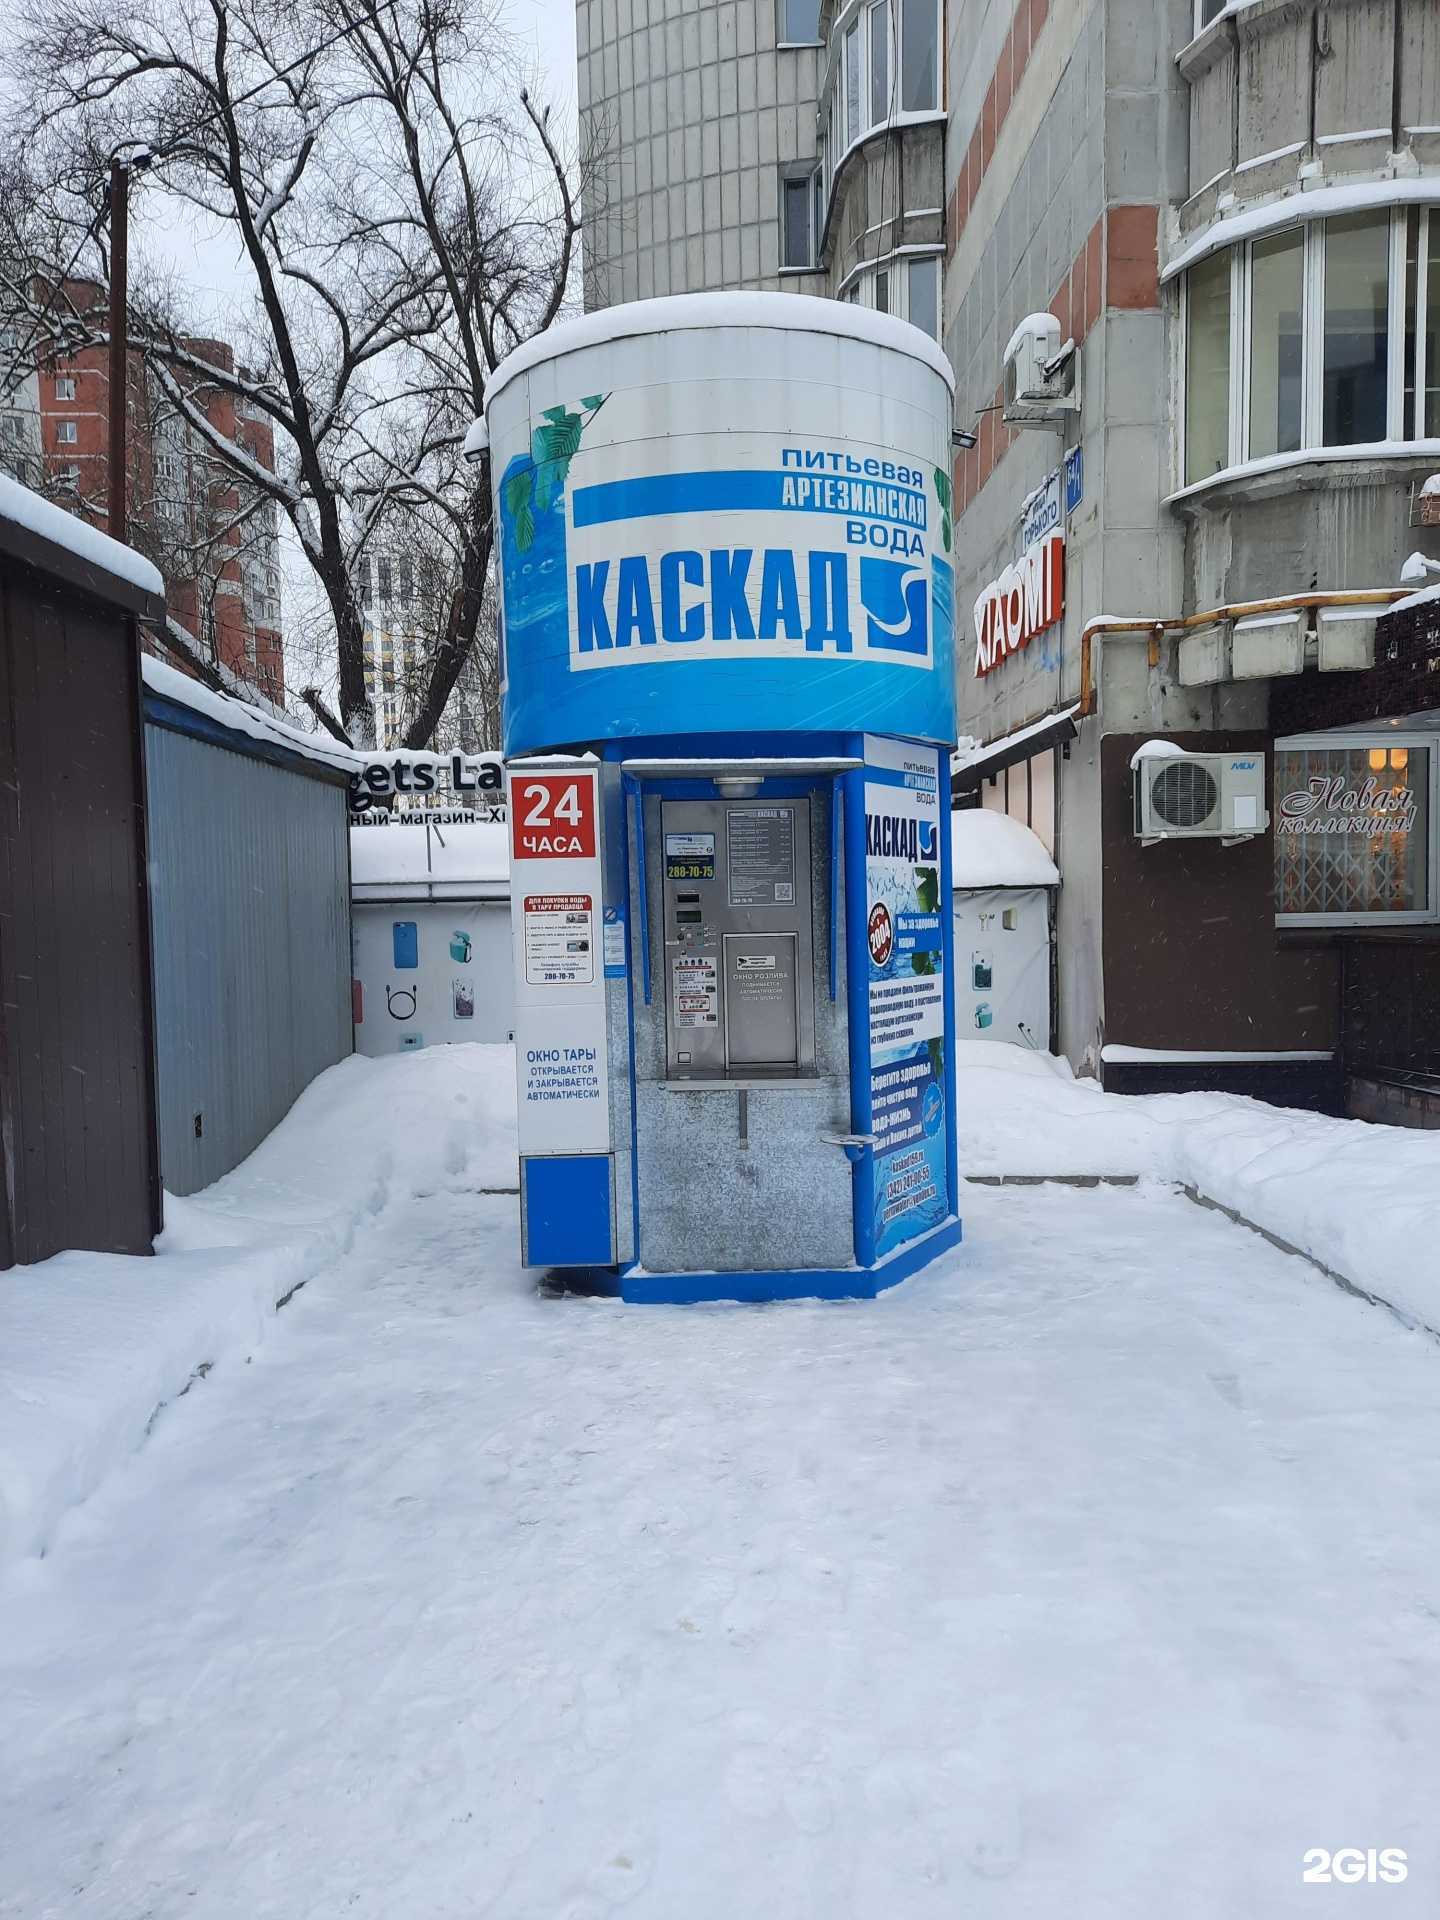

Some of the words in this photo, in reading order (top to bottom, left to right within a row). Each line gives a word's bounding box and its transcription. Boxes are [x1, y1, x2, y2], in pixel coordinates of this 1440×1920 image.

[782, 448, 923, 490] питьевая
[782, 475, 926, 525] АРТЕЗИАНСКАЯ
[846, 520, 925, 558] ВОДА
[1024, 501, 1057, 546] ГОРЬКОГО
[576, 549, 853, 654] КАСКАД
[975, 537, 1055, 678] XIAOMI
[523, 784, 583, 827] 24
[916, 792, 936, 805] ВОДА
[1280, 776, 1413, 818] Новая
[865, 814, 918, 863] КАСКАД
[1278, 806, 1417, 838] коллекция!
[523, 837, 583, 854] ЧАСА
[668, 866, 714, 878] 288-70-75
[870, 919, 890, 954] 2004
[527, 1050, 560, 1063] ОКНО
[563, 1048, 596, 1061] ТАРЫ
[530, 1065, 594, 1076] ОТКРЫВАЕТСЯ
[527, 1080, 534, 1089] И
[536, 1077, 598, 1089] ЗАКРЫВАЕТСЯ
[870, 1070, 900, 1091] Берегите
[900, 1062, 931, 1084] здоровье
[527, 1089, 600, 1101] АВТОМАТИЧЕСКИ
